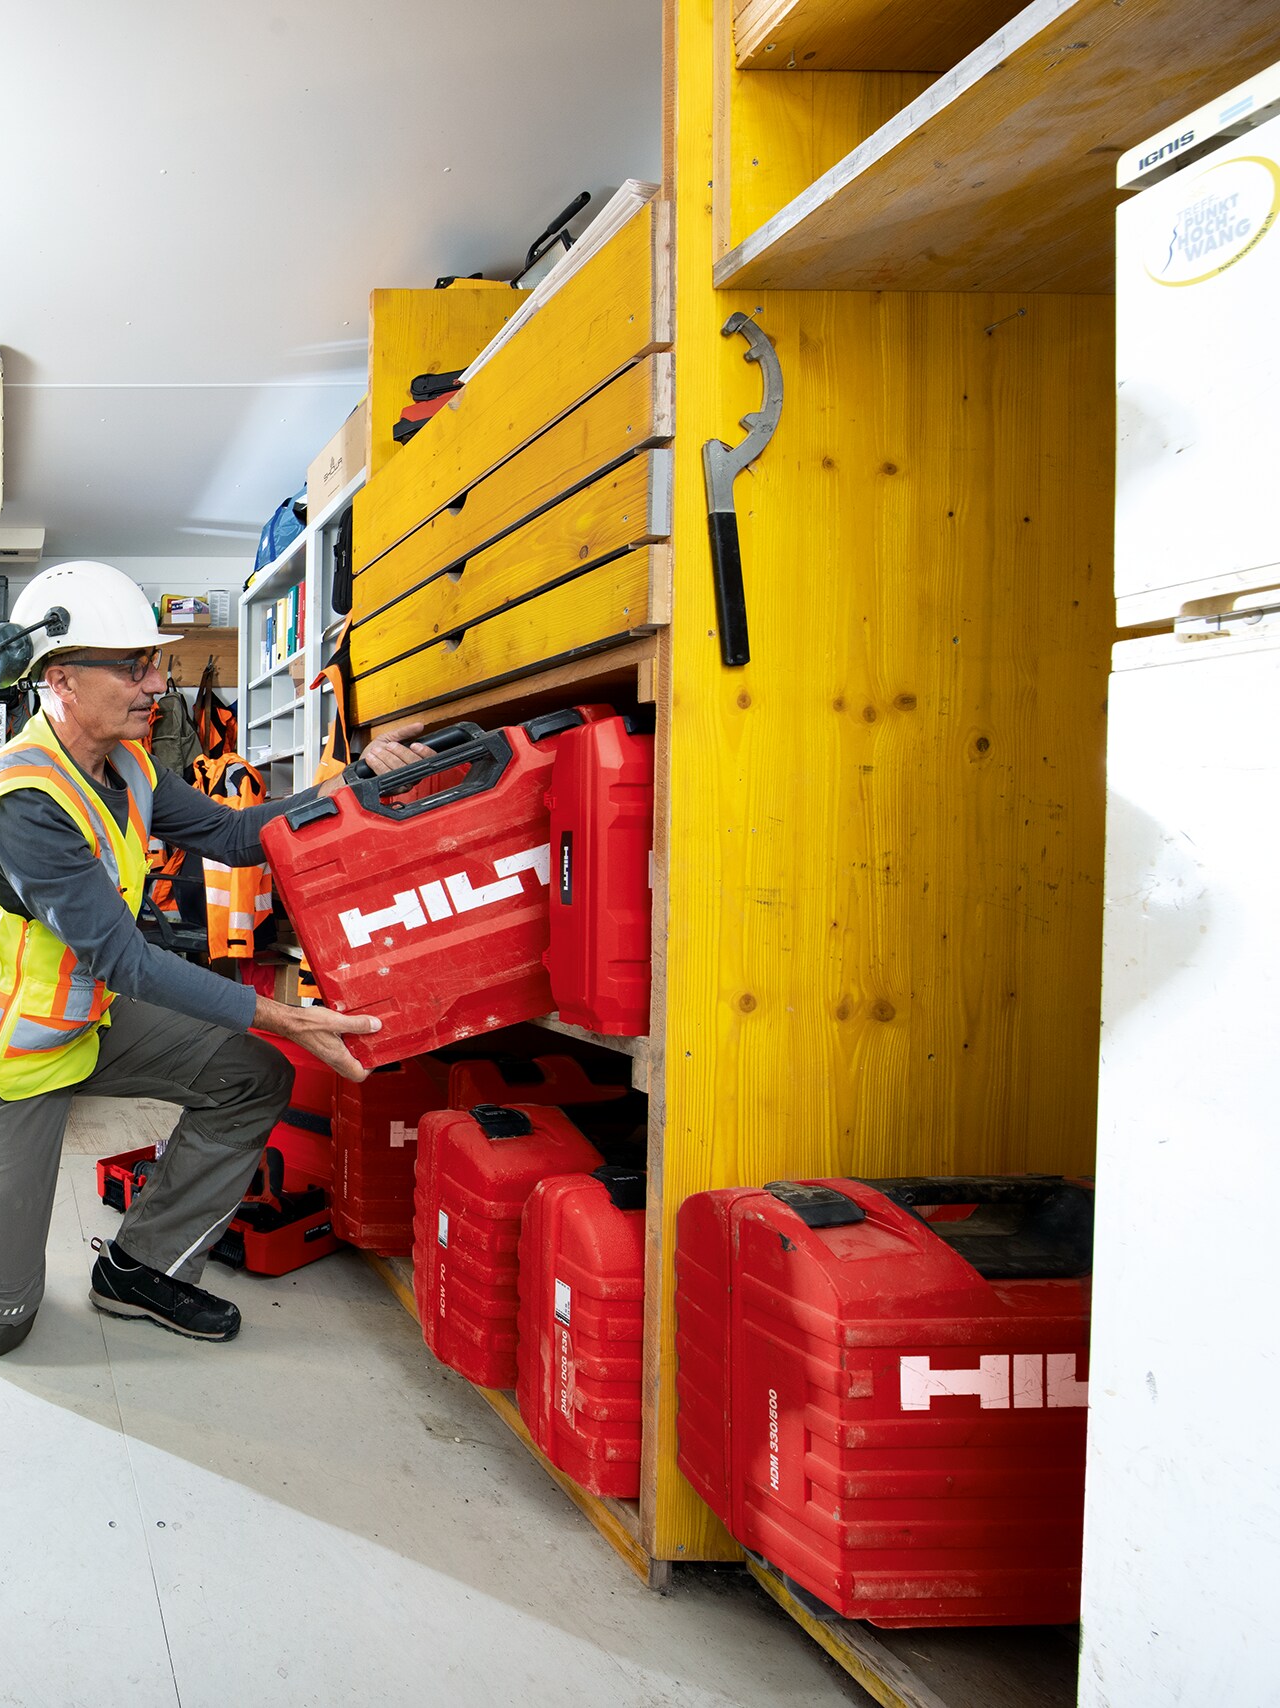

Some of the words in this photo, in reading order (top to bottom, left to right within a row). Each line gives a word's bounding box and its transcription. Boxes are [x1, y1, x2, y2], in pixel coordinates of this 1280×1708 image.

[1138, 130, 1195, 171] IGNIS
[1178, 213, 1236, 250] HOCH-
[1185, 192, 1240, 233] PUNKT
[1184, 218, 1251, 262] WANG
[440, 1263, 446, 1282] 70
[768, 1388, 779, 1453] 330/500
[770, 1453, 779, 1491] HDM
